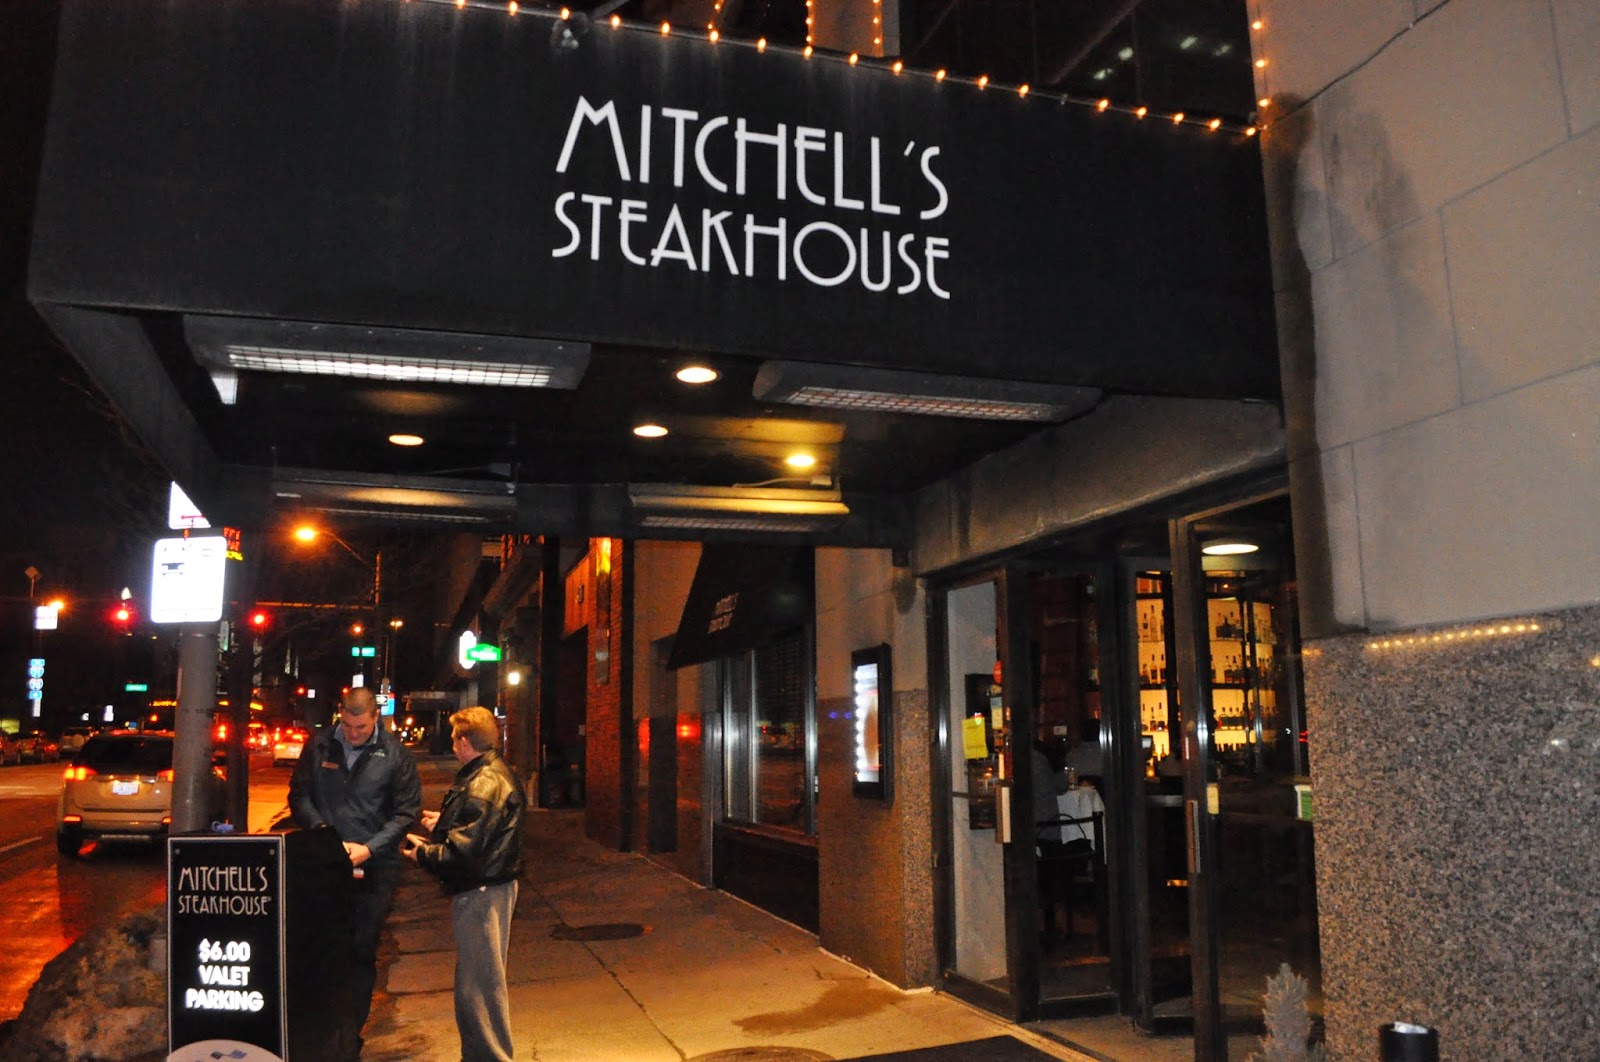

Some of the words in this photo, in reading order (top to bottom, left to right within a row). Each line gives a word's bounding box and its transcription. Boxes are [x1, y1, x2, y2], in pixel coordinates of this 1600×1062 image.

[556, 96, 949, 220] MITCHELL'S
[552, 192, 951, 299] STEAKHOUSE
[178, 866, 269, 892] MITCHELL'S
[198, 938, 251, 963] $6.00
[198, 965, 251, 986] VALET
[185, 988, 265, 1012] PARKING
